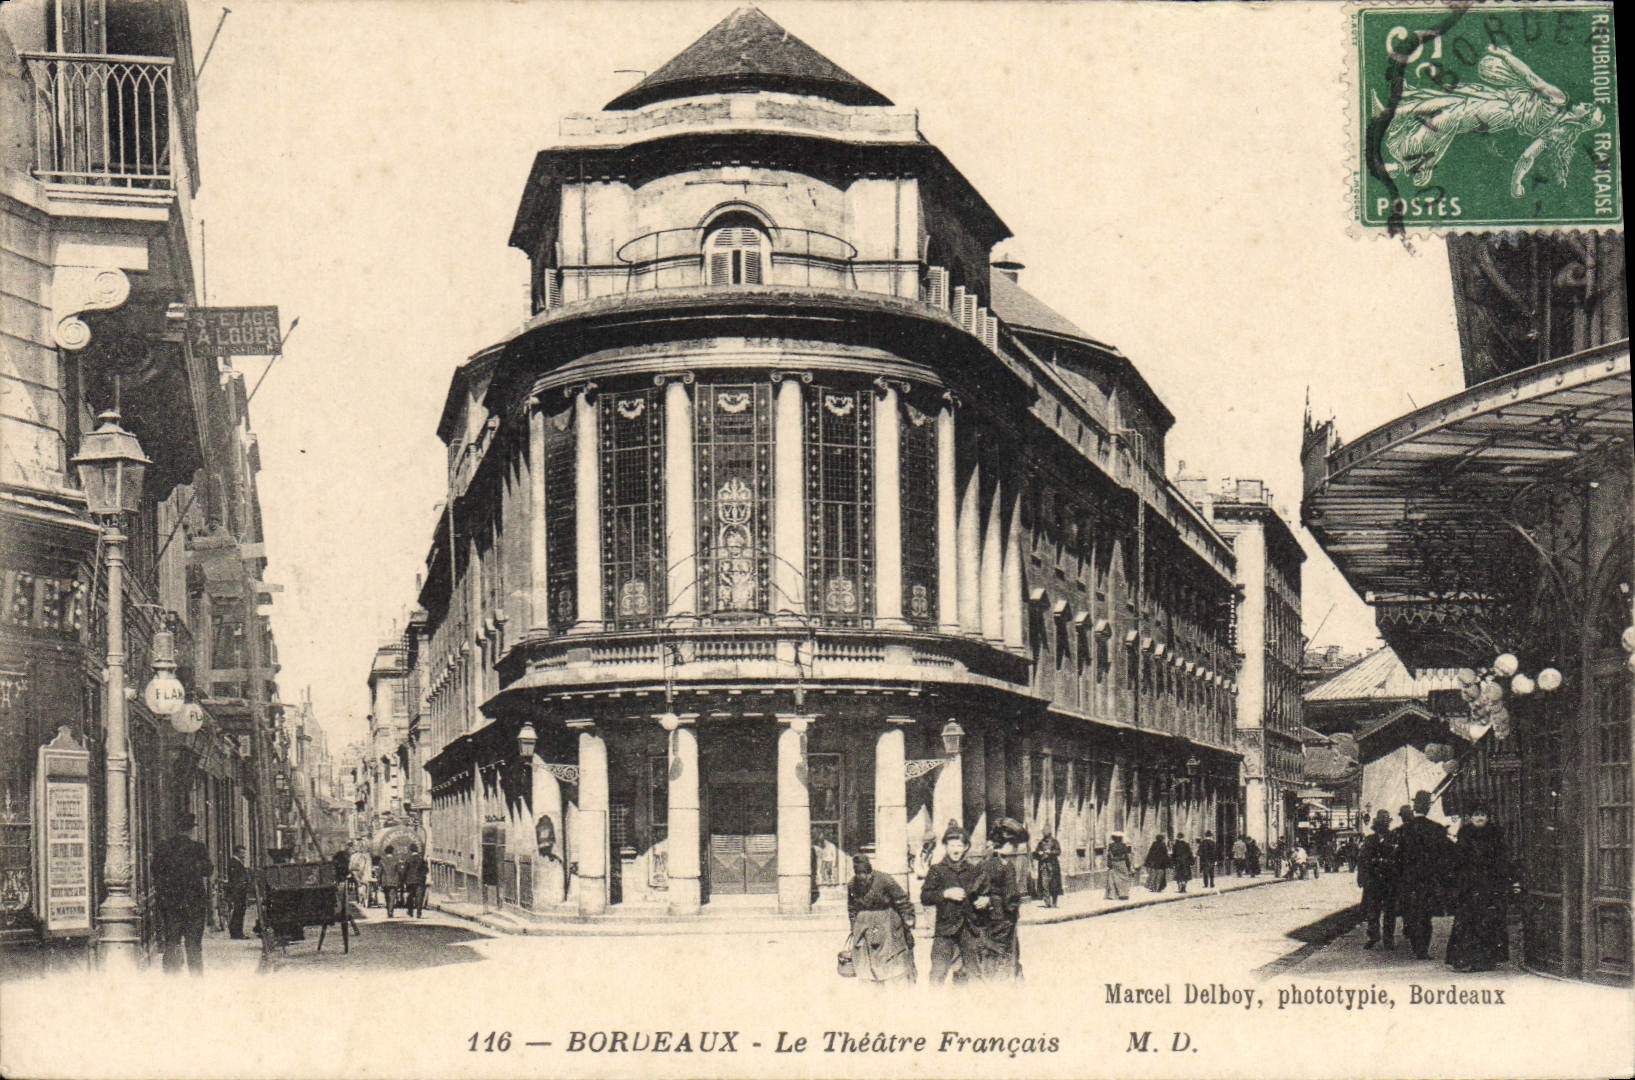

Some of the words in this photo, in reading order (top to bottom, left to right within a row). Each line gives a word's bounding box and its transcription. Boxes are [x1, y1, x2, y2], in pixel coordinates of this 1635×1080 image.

[1590, 14, 1611, 104] REPUBLIQUE
[1376, 196, 1462, 217] POSTES
[217, 325, 280, 346] LOUER
